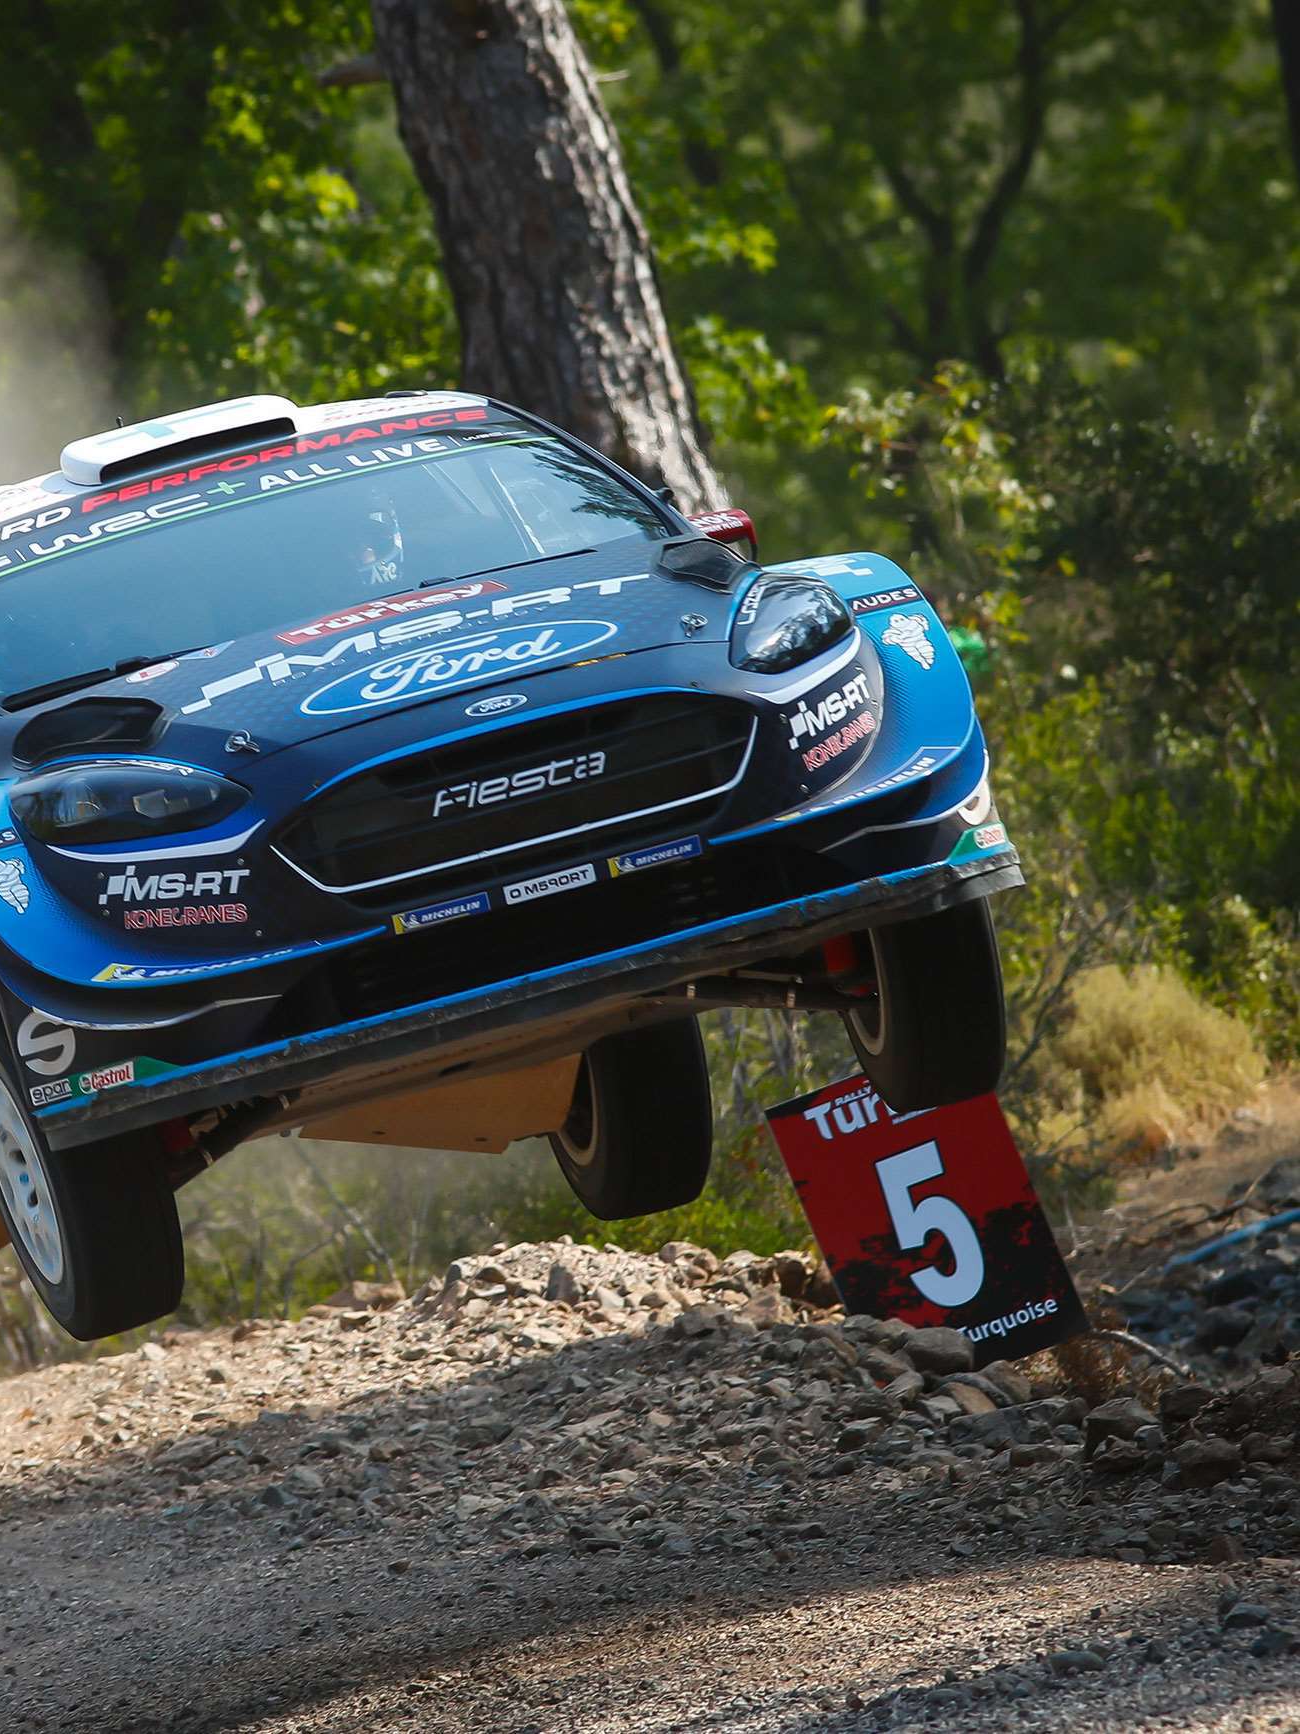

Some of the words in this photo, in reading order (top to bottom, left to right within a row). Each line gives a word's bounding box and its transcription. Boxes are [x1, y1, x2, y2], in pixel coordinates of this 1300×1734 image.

[82, 409, 488, 513] PERFORMANCE
[259, 463, 342, 491] ALL
[346, 438, 448, 467] LIVE
[852, 588, 918, 611] AUDES
[267, 574, 649, 681] MS-RT
[361, 630, 561, 700] Ford
[635, 843, 693, 867] MICHELIN
[124, 869, 251, 902] MS-RT
[124, 903, 248, 930] KONECRANES
[421, 900, 481, 923] MICHELIN
[91, 1065, 132, 1090] Castrol
[874, 1139, 985, 1308] 5
